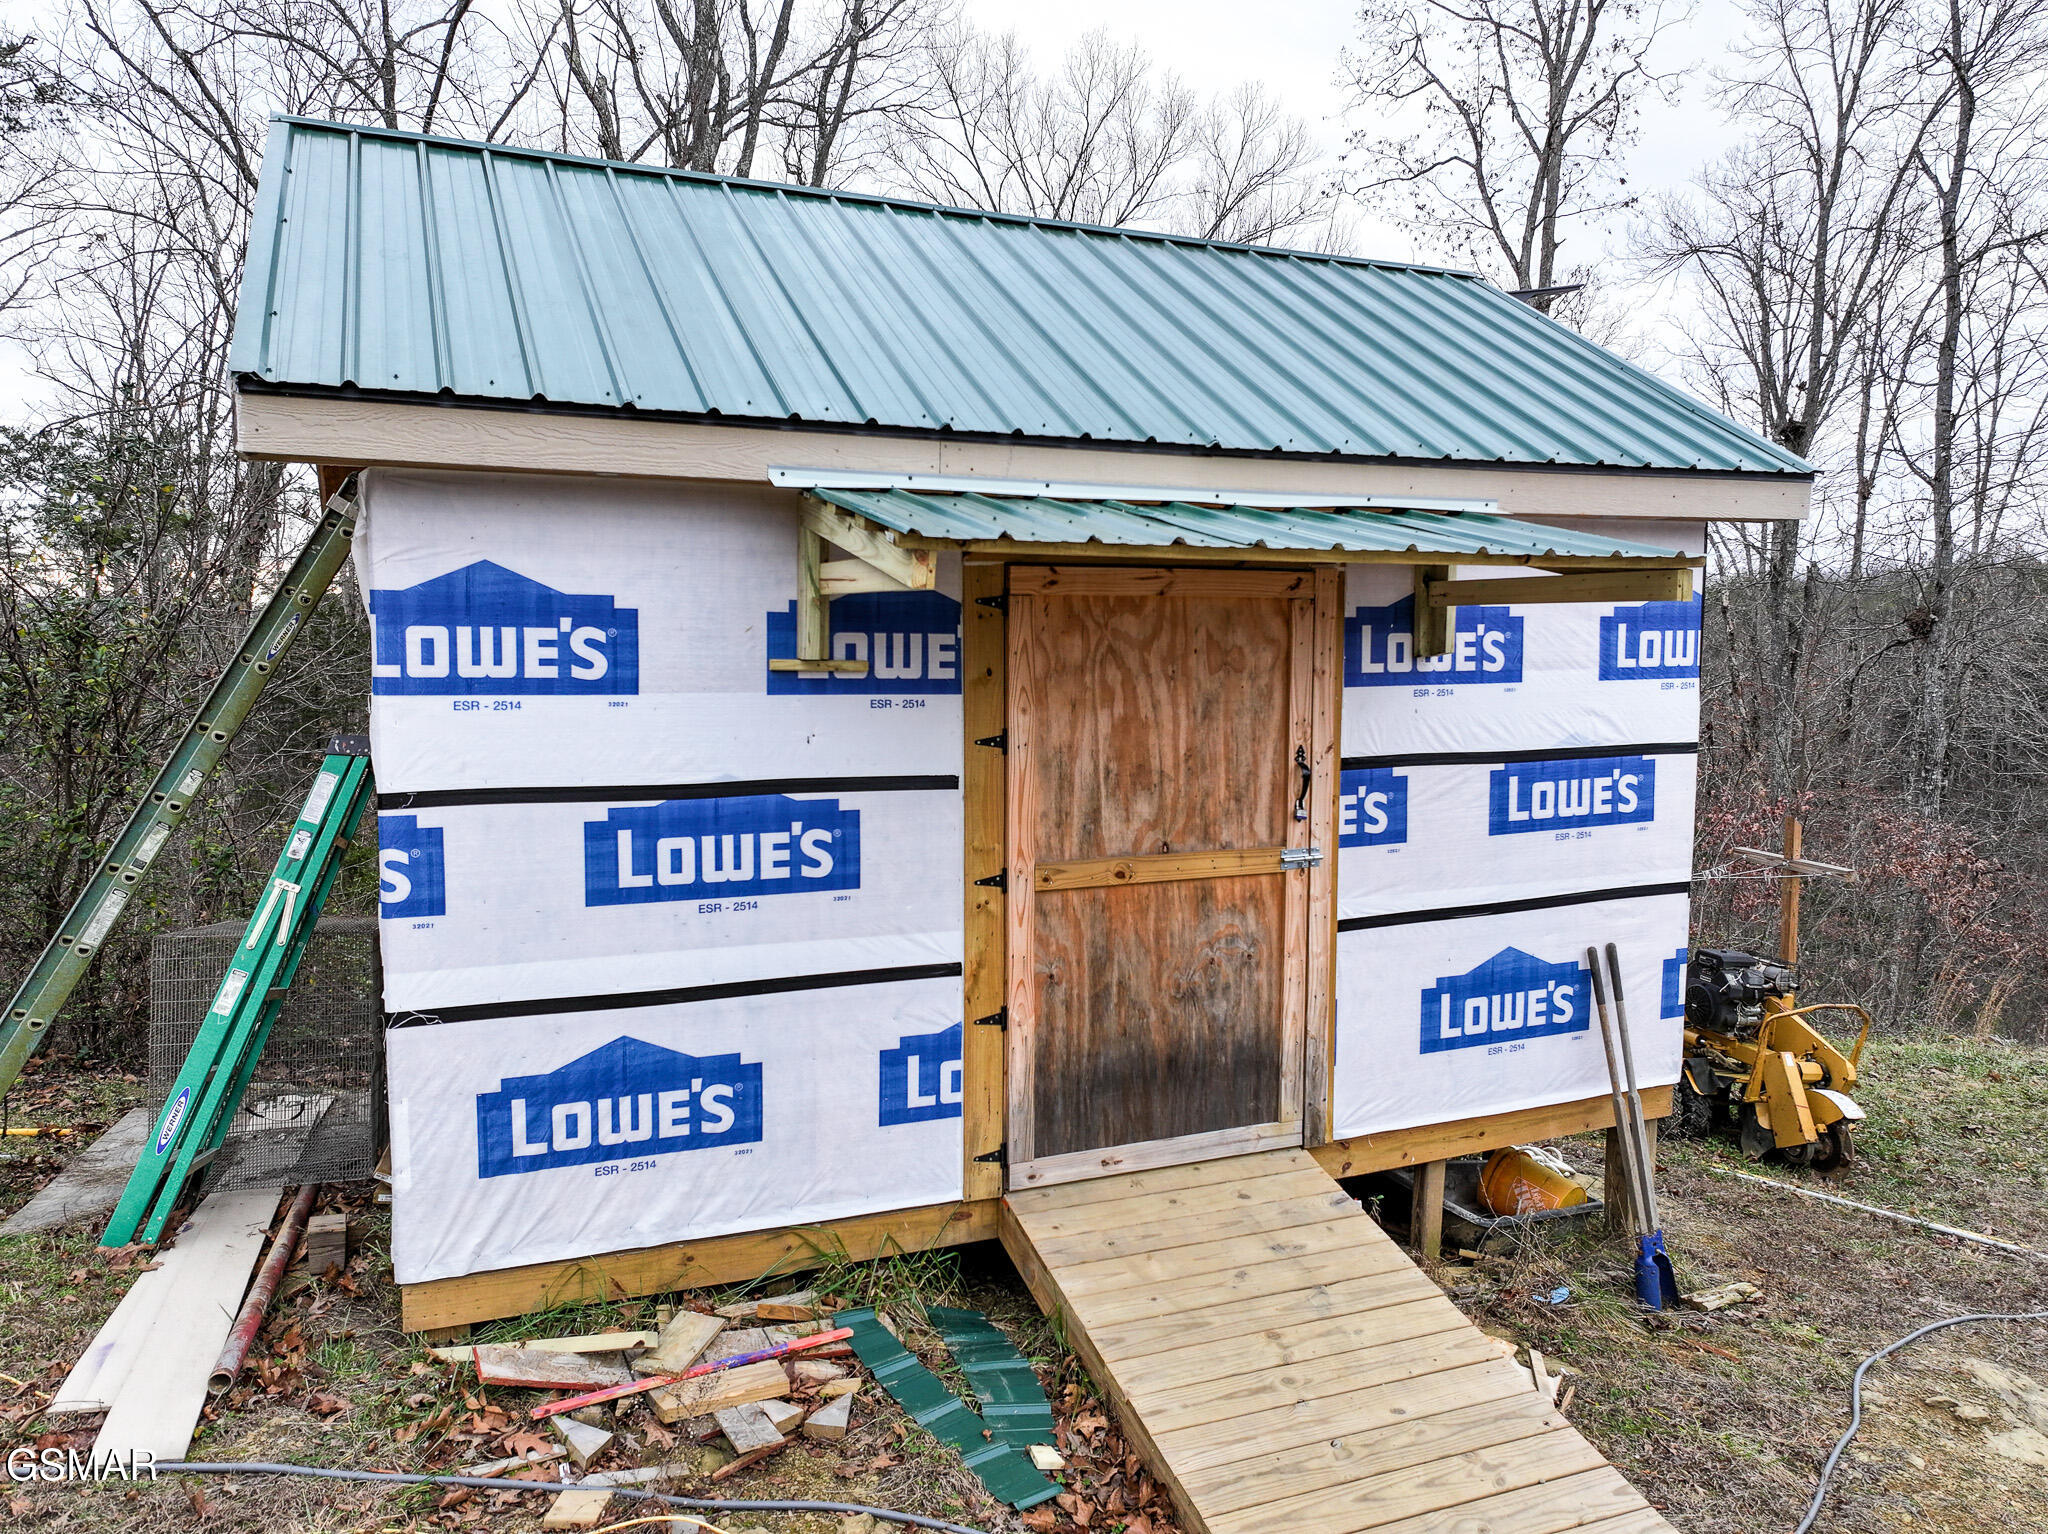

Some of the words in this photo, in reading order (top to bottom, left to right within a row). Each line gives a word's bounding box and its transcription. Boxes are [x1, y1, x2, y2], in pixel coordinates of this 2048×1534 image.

[272, 621, 295, 651] WERNER
[1617, 623, 1701, 668] LOW
[870, 700, 892, 709] ESR
[902, 700, 926, 709] 2514
[1413, 689, 1430, 698] ESR
[1436, 689, 1454, 697] 2514
[453, 700, 481, 711] ESR
[493, 700, 522, 711] 2514
[1508, 769, 1639, 821] LOWE'S
[1555, 832, 1570, 841] ESR
[1576, 831, 1592, 840] 2514
[617, 821, 835, 888] LOWE'S
[698, 903, 722, 914] ESR
[733, 901, 758, 912] 2514
[1440, 980, 1575, 1039] LOWE'S
[1487, 1046, 1503, 1056] ESR
[1509, 1043, 1525, 1053] 2514
[161, 1100, 185, 1141] WERNER
[511, 1078, 736, 1157] LOWE'S
[594, 1165, 619, 1177] ESR
[630, 1160, 656, 1173] 2514
